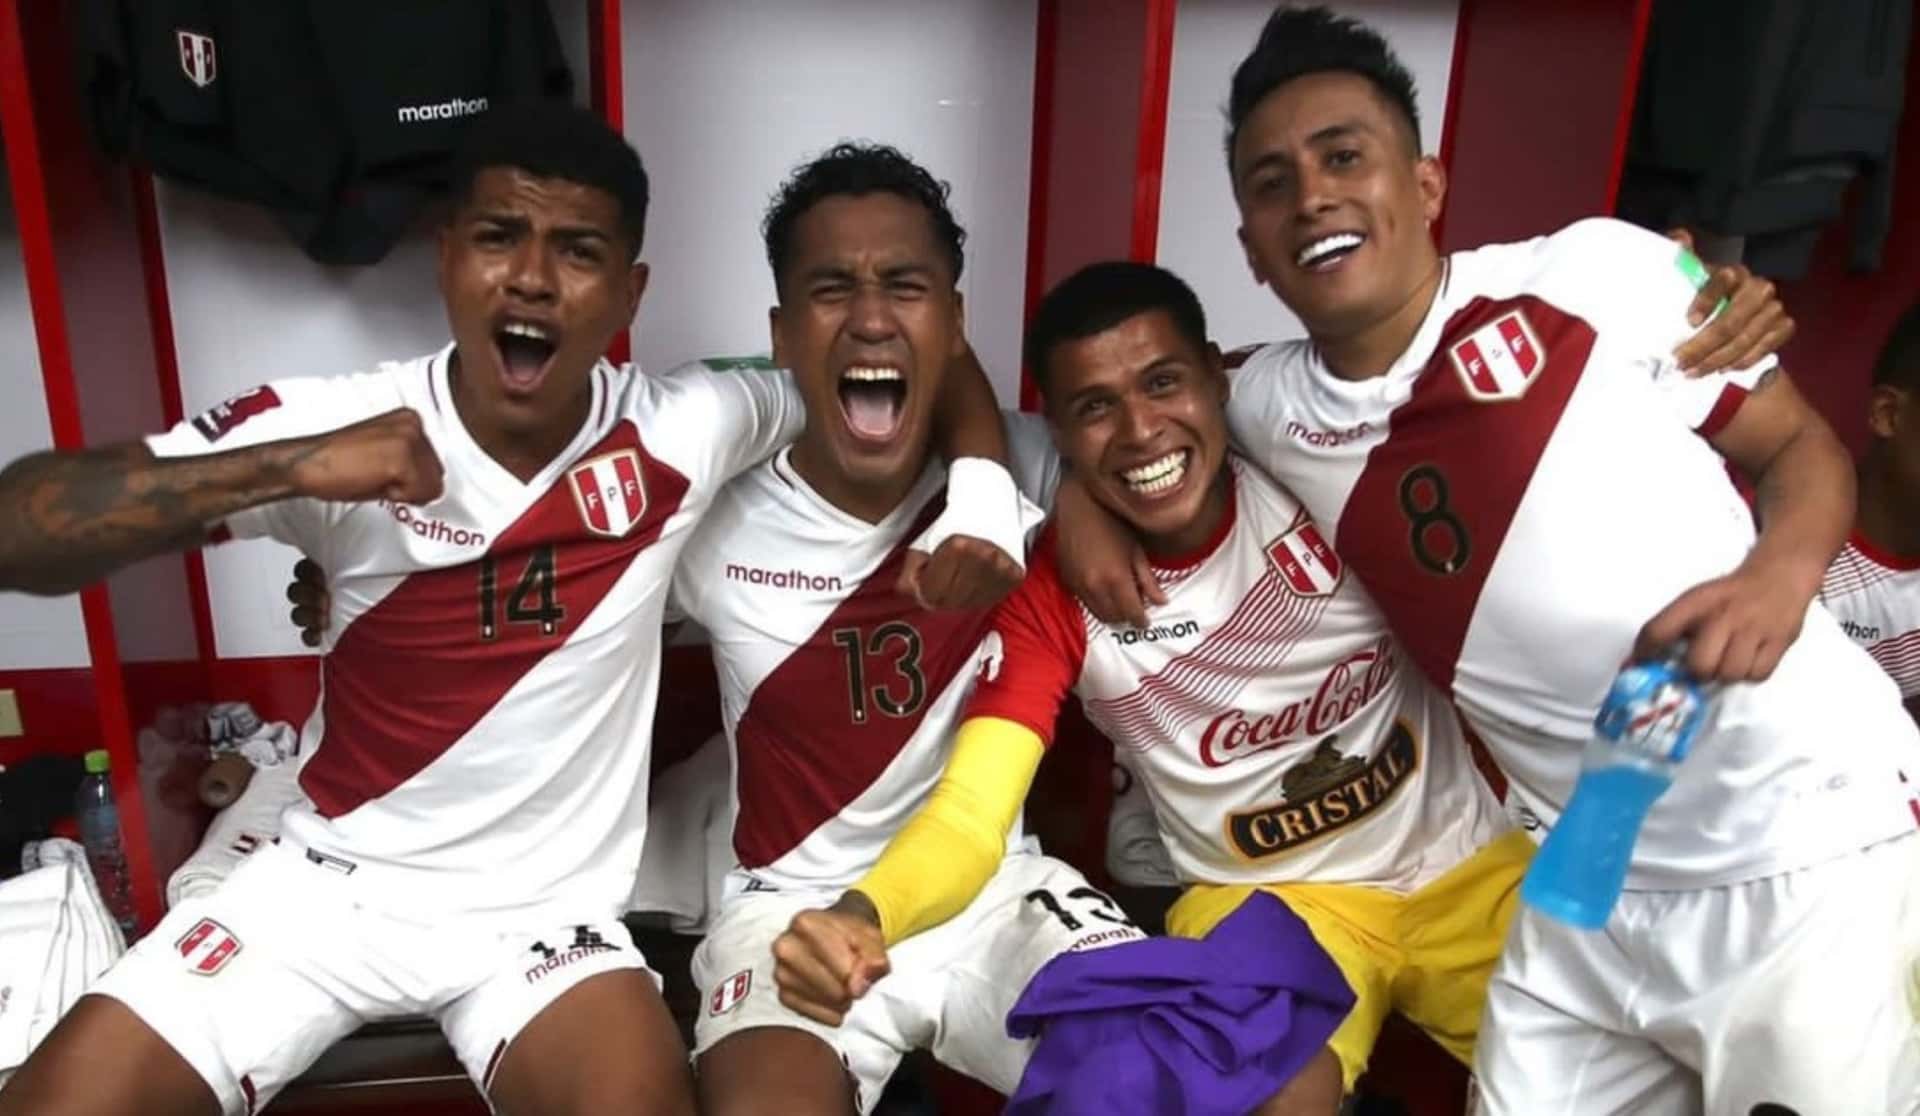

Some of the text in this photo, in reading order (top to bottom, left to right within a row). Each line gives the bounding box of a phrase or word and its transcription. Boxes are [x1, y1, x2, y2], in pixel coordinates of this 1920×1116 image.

[398, 96, 488, 122] marathon
[1397, 463, 1470, 575] 8
[479, 546, 565, 640] 14
[726, 562, 842, 592] marathon
[833, 620, 926, 724] 13
